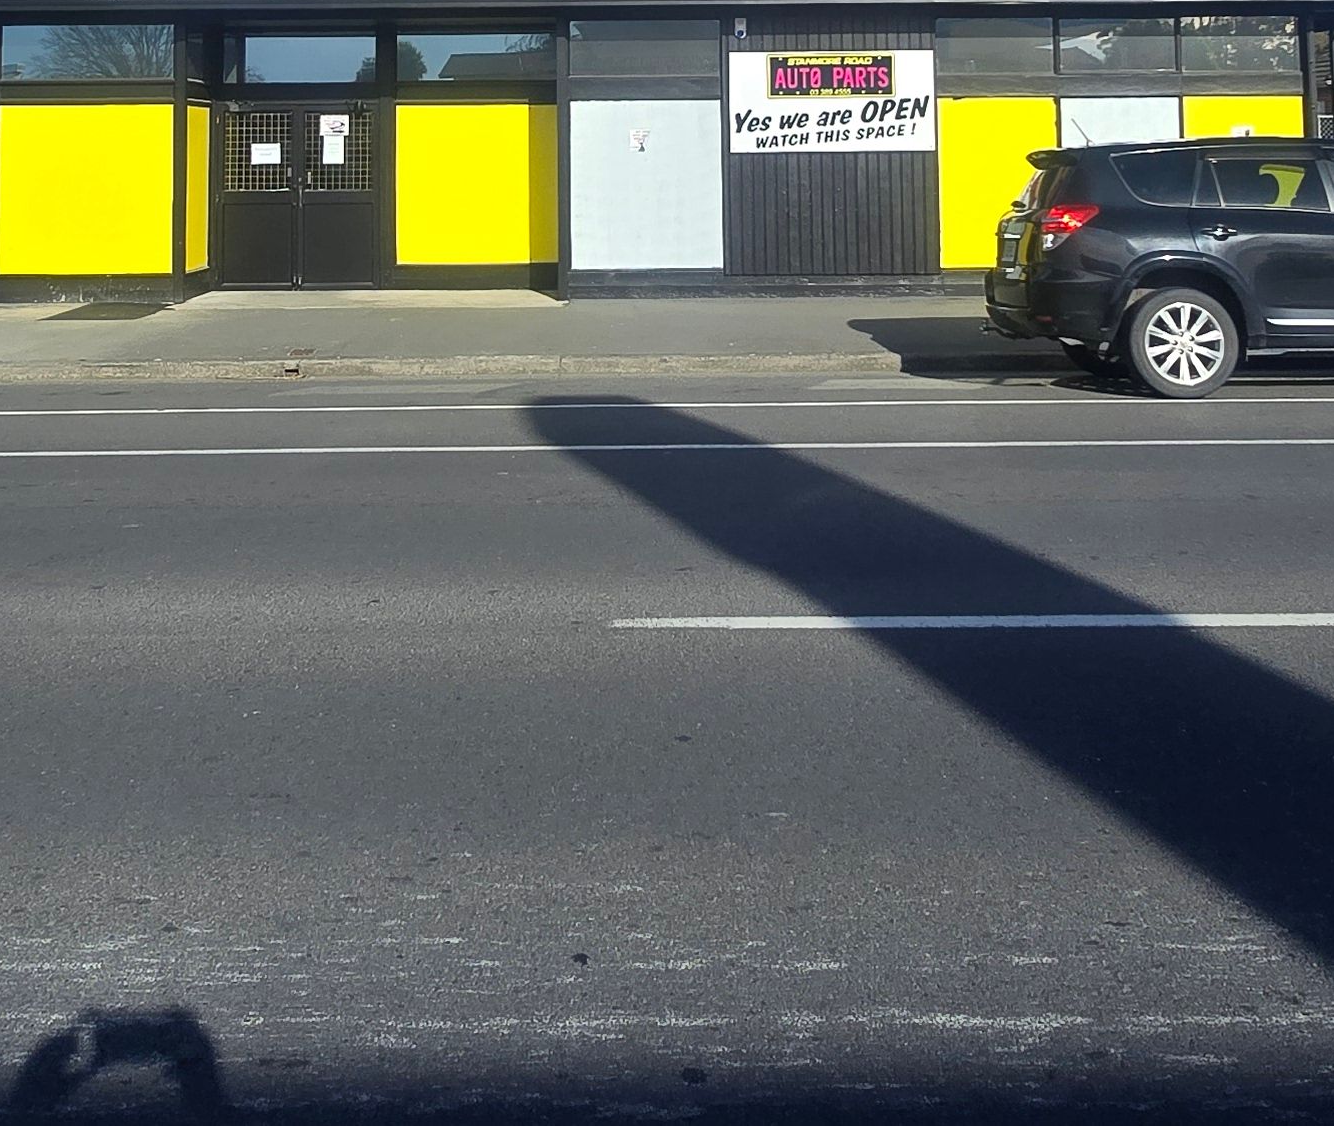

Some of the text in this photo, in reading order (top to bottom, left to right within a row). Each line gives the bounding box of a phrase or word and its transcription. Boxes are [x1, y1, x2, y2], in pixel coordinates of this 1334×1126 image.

[844, 57, 873, 65] ROAD
[833, 67, 889, 88] PARTS
[735, 95, 930, 133] Yes we are OPEN
[756, 132, 809, 148] WATCH
[817, 129, 850, 144] THIS
